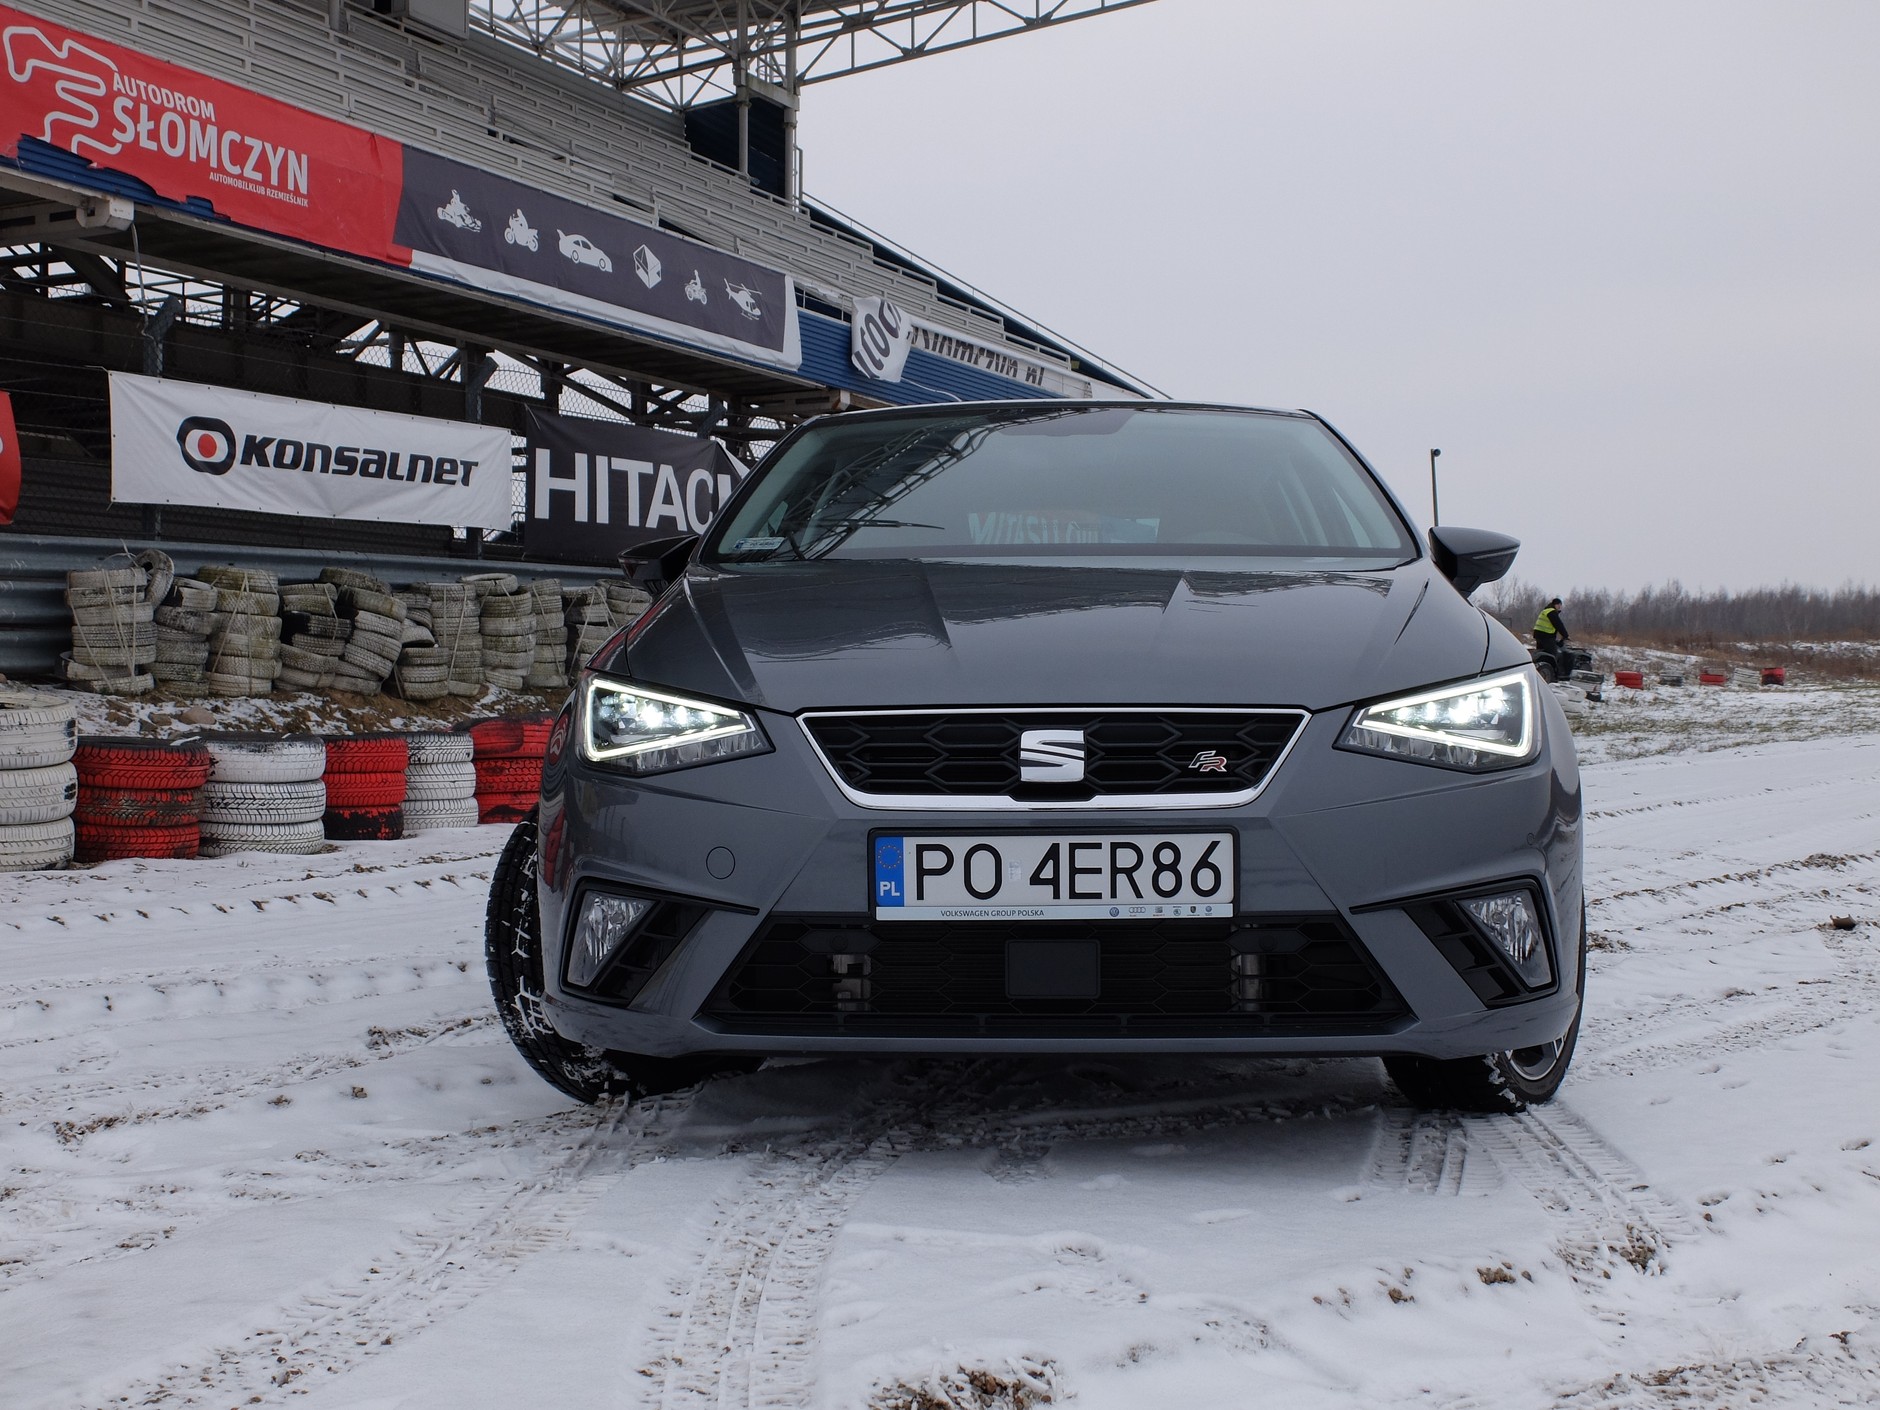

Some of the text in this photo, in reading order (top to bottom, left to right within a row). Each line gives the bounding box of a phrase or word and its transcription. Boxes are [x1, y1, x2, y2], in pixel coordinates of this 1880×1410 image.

[113, 71, 216, 122] AUTODROM
[112, 96, 308, 195] SŁOMCZYN
[209, 172, 265, 195] AUTOMOBILKLUB
[1189, 750, 1227, 772] FR
[915, 840, 1223, 901] PO 4ER86
[879, 881, 900, 897] PL
[940, 909, 1045, 917] VOLKSWAGEN GROUP POLSKA
